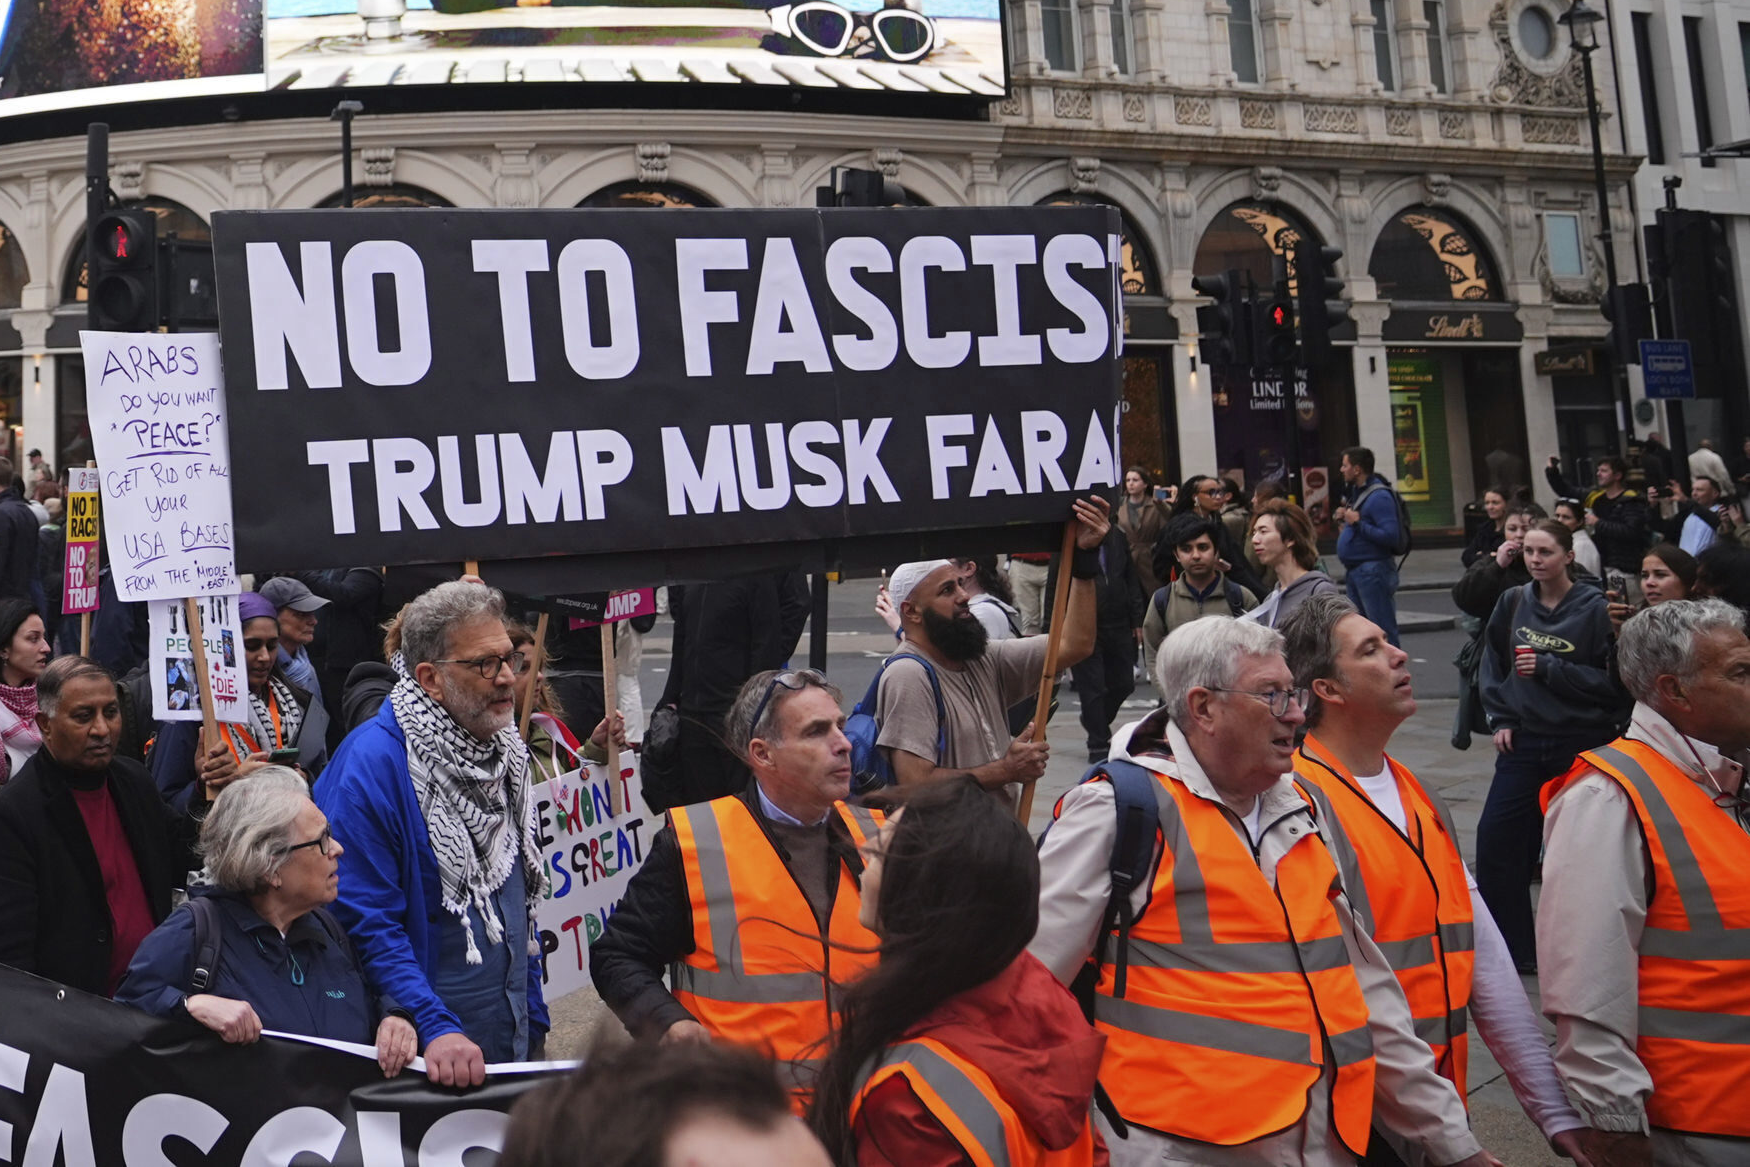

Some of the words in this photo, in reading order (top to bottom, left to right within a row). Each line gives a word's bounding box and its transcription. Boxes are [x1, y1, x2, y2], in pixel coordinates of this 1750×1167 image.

[246, 239, 433, 391] NO
[472, 237, 641, 384] TO
[675, 233, 1123, 378] FASCIS
[1425, 315, 1472, 338] Lindt
[100, 345, 199, 386] ARABS
[120, 394, 142, 413] DO
[147, 391, 181, 415] YOU
[185, 388, 218, 406] WANT
[107, 466, 145, 499] GET
[150, 461, 178, 488] RID
[185, 463, 203, 480] OF
[305, 427, 634, 536] TRUMP
[661, 417, 902, 517] MUSK
[71, 496, 86, 517] NO
[123, 531, 167, 561] USA
[180, 521, 230, 548] BASES
[69, 545, 86, 567] NO
[68, 567, 85, 588] TO
[125, 575, 158, 597] FROM
[165, 569, 190, 585] THE
